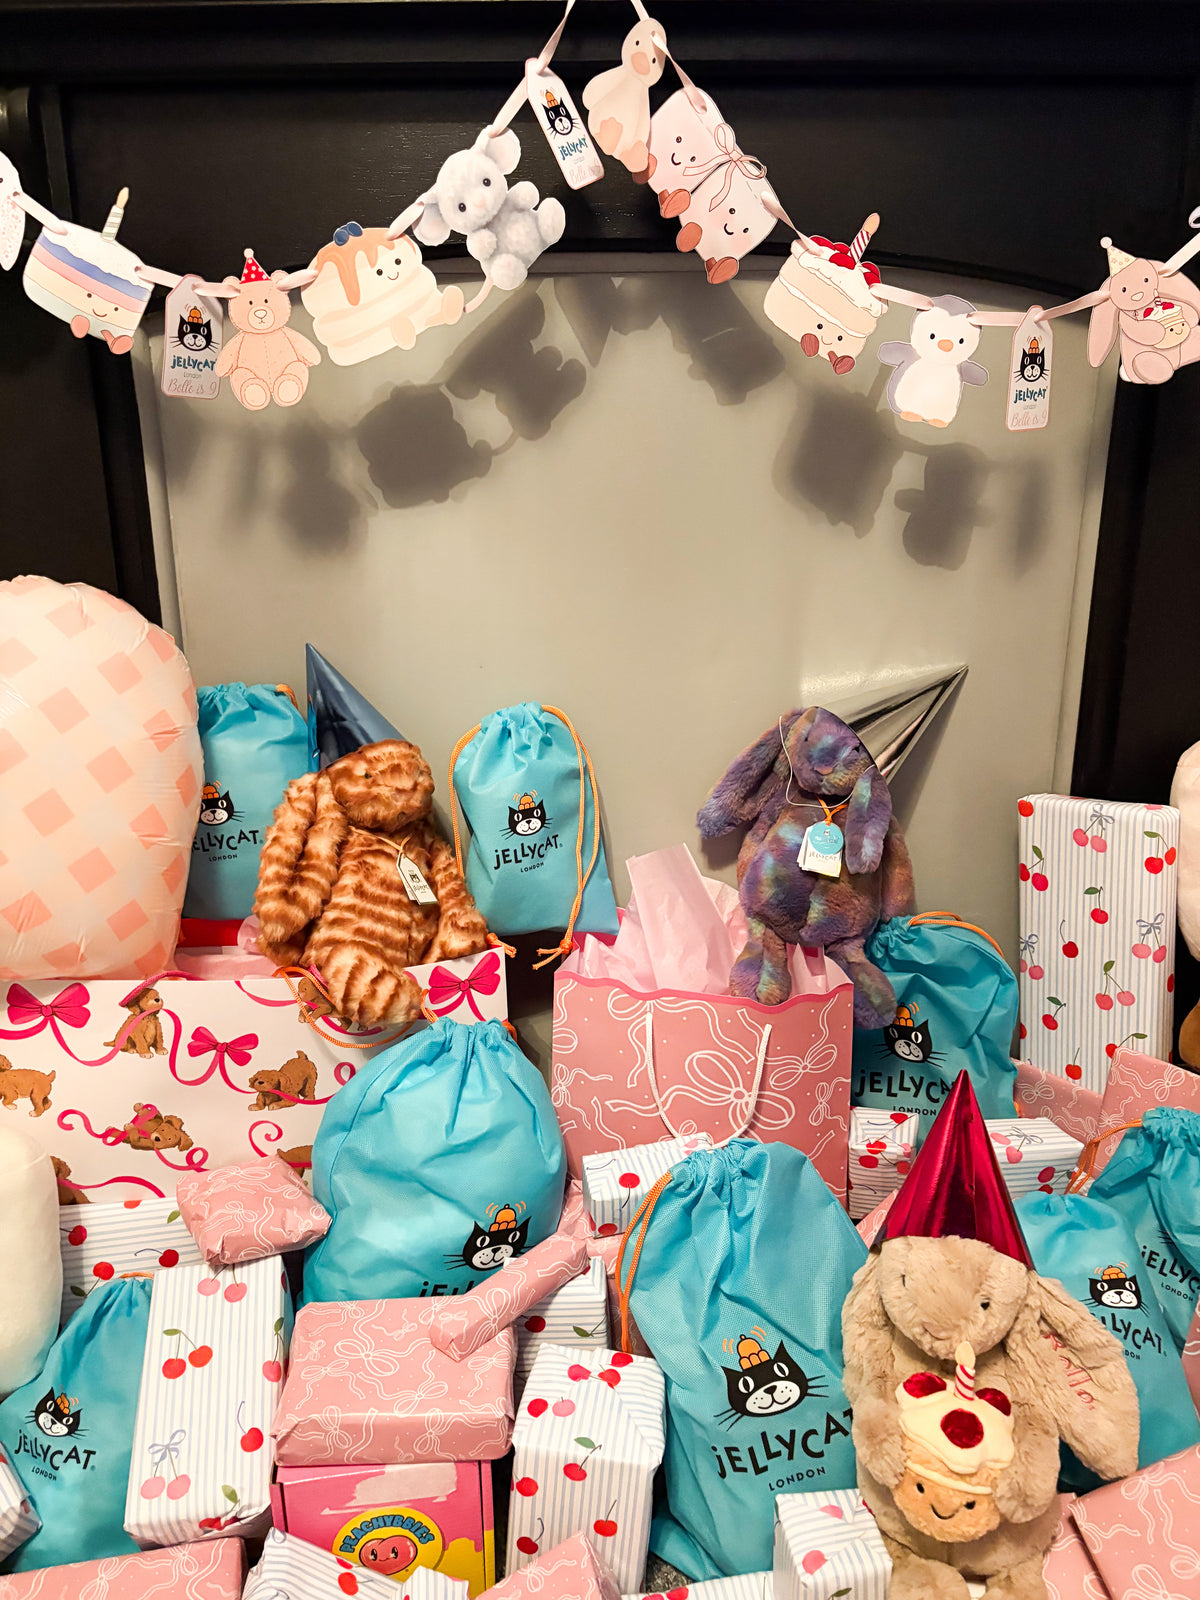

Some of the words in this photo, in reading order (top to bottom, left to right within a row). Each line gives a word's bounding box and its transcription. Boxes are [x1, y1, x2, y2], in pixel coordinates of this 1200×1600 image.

[168, 378, 193, 393] Belle
[195, 382, 204, 395] is
[208, 382, 217, 395] 9
[192, 829, 259, 853] ELLYCAT
[209, 853, 238, 862] LONDON
[520, 861, 545, 873] LONDON
[854, 1069, 955, 1103] jELLYCA
[893, 1105, 937, 1116] LONDON
[1161, 1282, 1194, 1302] LONDON
[1124, 1349, 1141, 1360] DON
[31, 1465, 58, 1481] LONDON
[768, 1466, 826, 1491] LONDON
[339, 1514, 435, 1553] PEACHYBBIES
